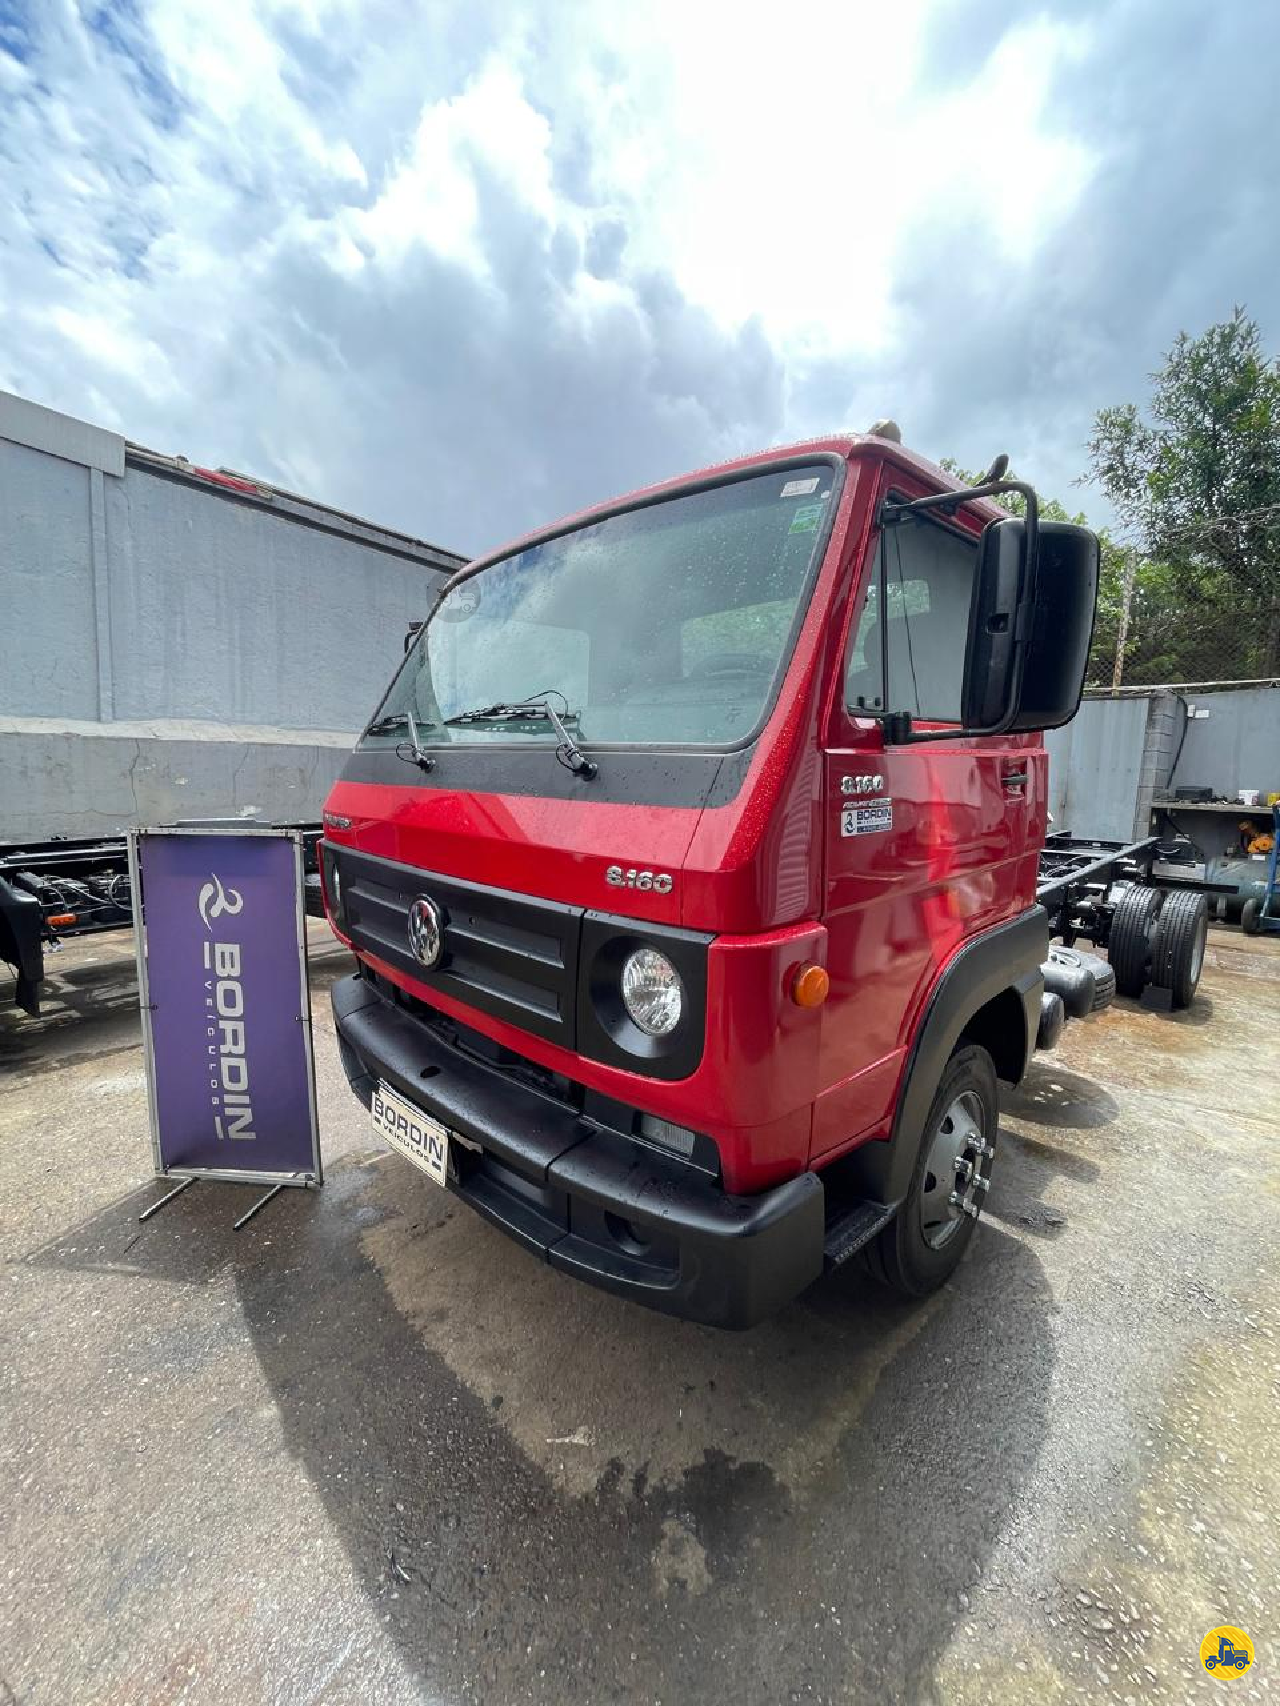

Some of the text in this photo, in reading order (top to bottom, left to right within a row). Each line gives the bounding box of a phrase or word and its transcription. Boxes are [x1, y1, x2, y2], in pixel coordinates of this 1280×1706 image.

[606, 866, 673, 894] 8.160
[214, 943, 257, 1140] BORDIN
[374, 1096, 443, 1161] BORDIN
